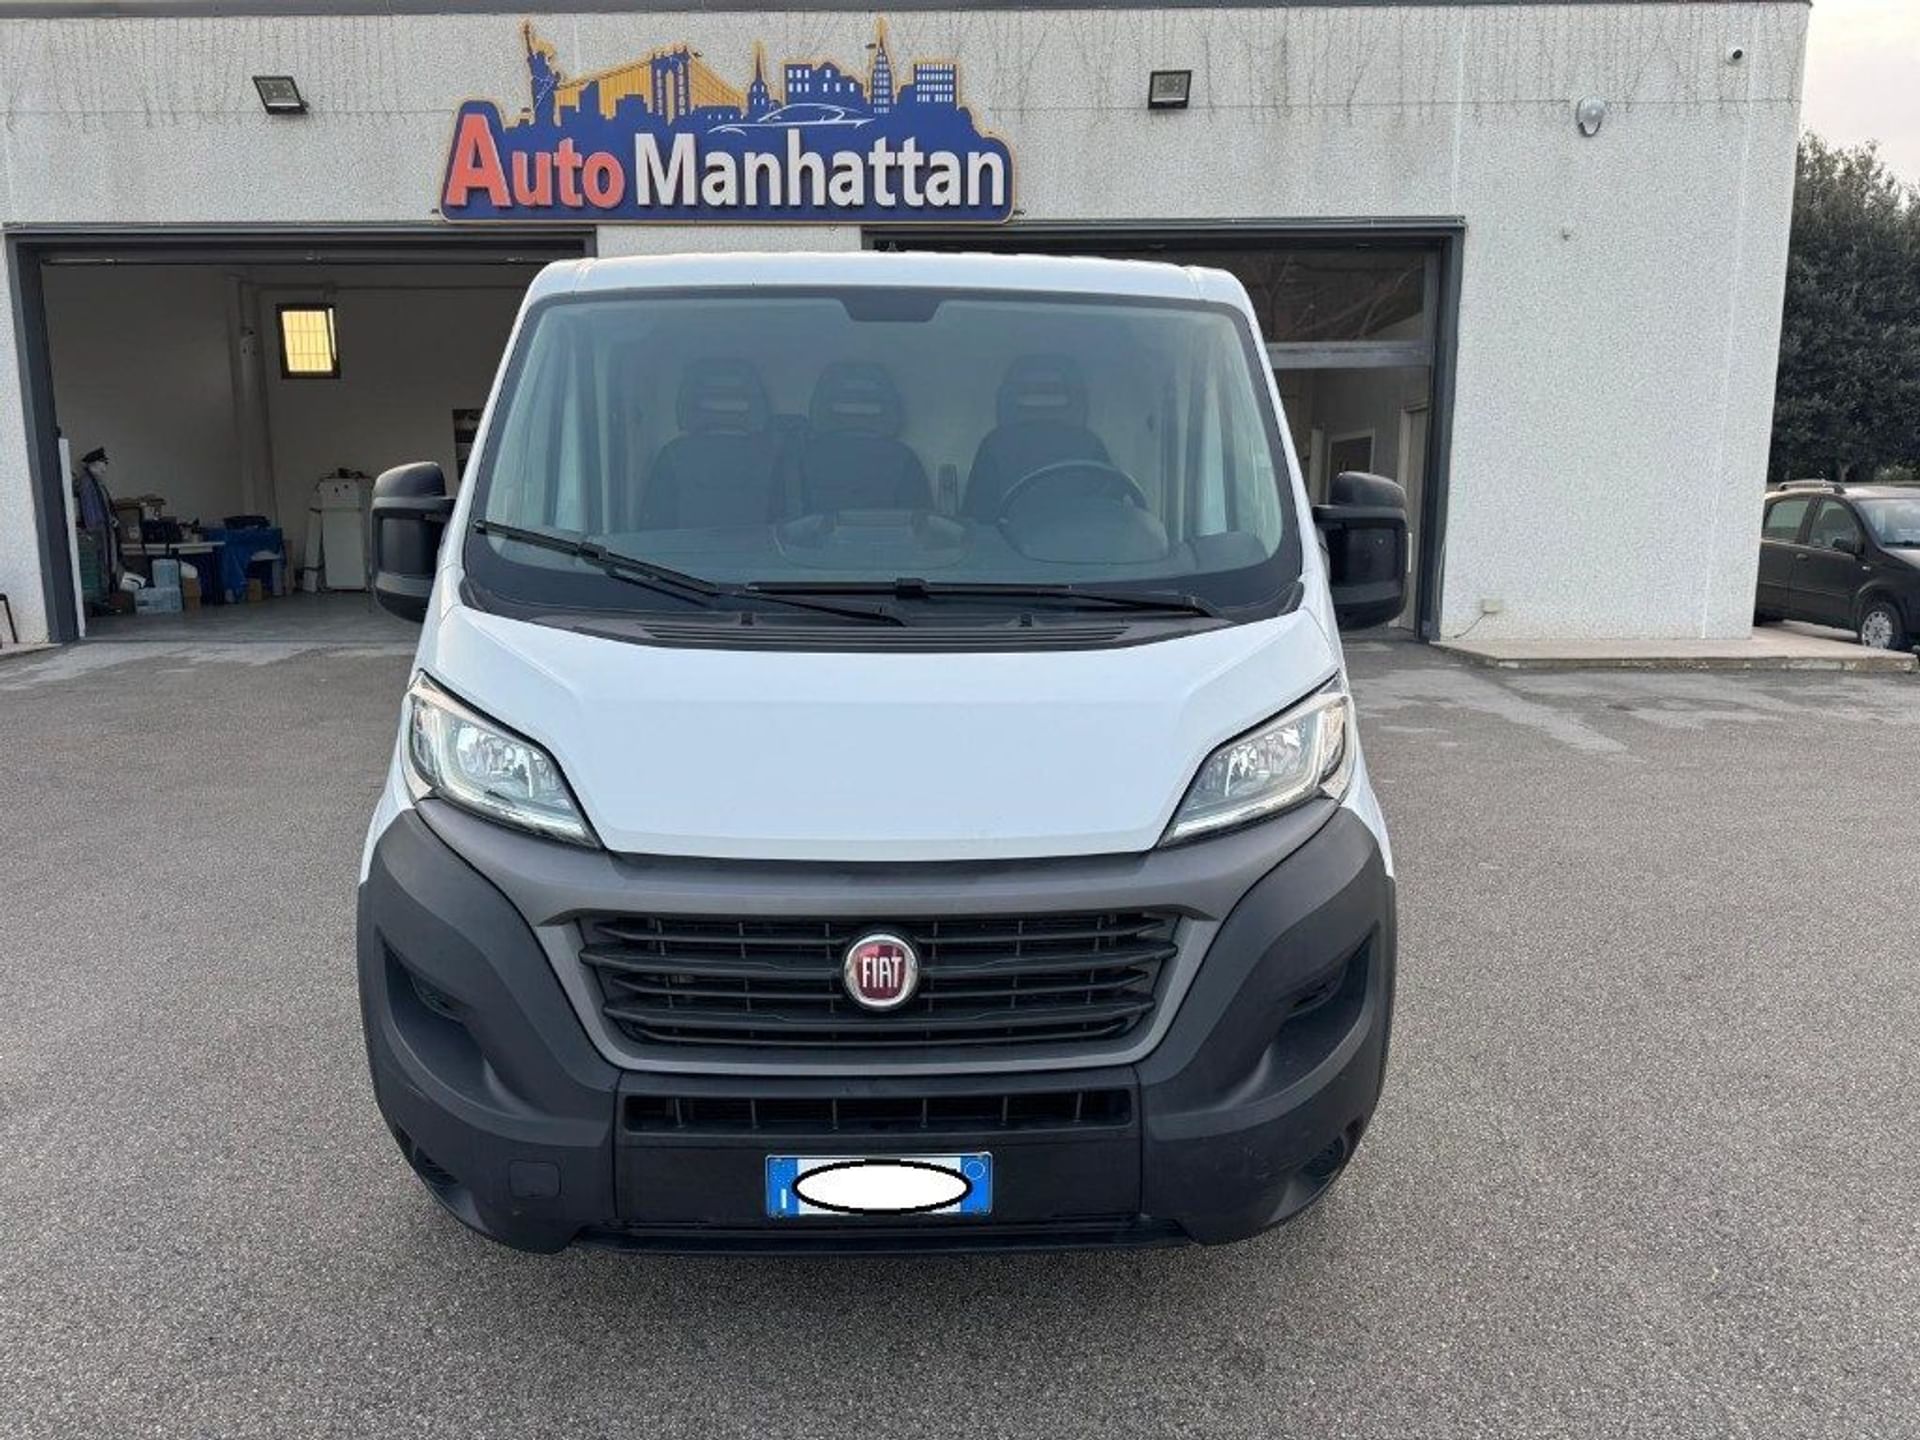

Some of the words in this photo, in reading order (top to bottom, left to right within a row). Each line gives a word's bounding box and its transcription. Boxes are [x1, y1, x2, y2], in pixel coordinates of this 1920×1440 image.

[443, 114, 625, 208] Auto
[634, 128, 1006, 208] Manhattan
[861, 956, 902, 989] FIAT
